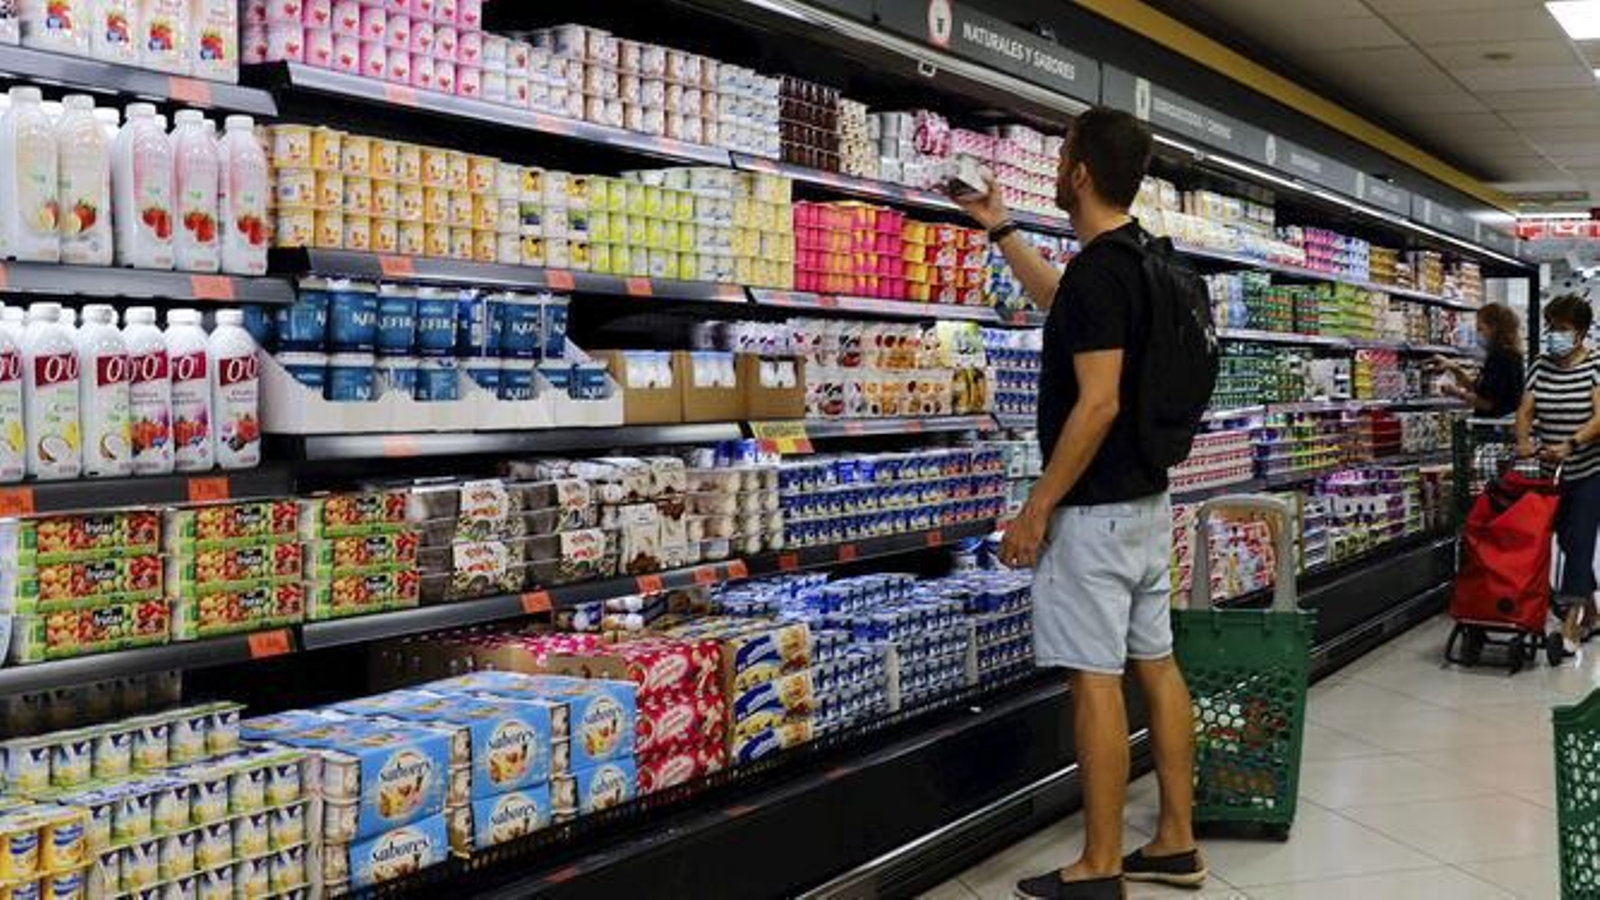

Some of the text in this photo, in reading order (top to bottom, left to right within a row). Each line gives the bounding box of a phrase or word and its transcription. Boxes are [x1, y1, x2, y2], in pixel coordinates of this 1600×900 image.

[963, 22, 1075, 81] NATURALES Y SABORES
[489, 730, 535, 749] sabores
[380, 760, 430, 781] sabores
[491, 804, 536, 824] sabores
[372, 839, 429, 861] sabores
